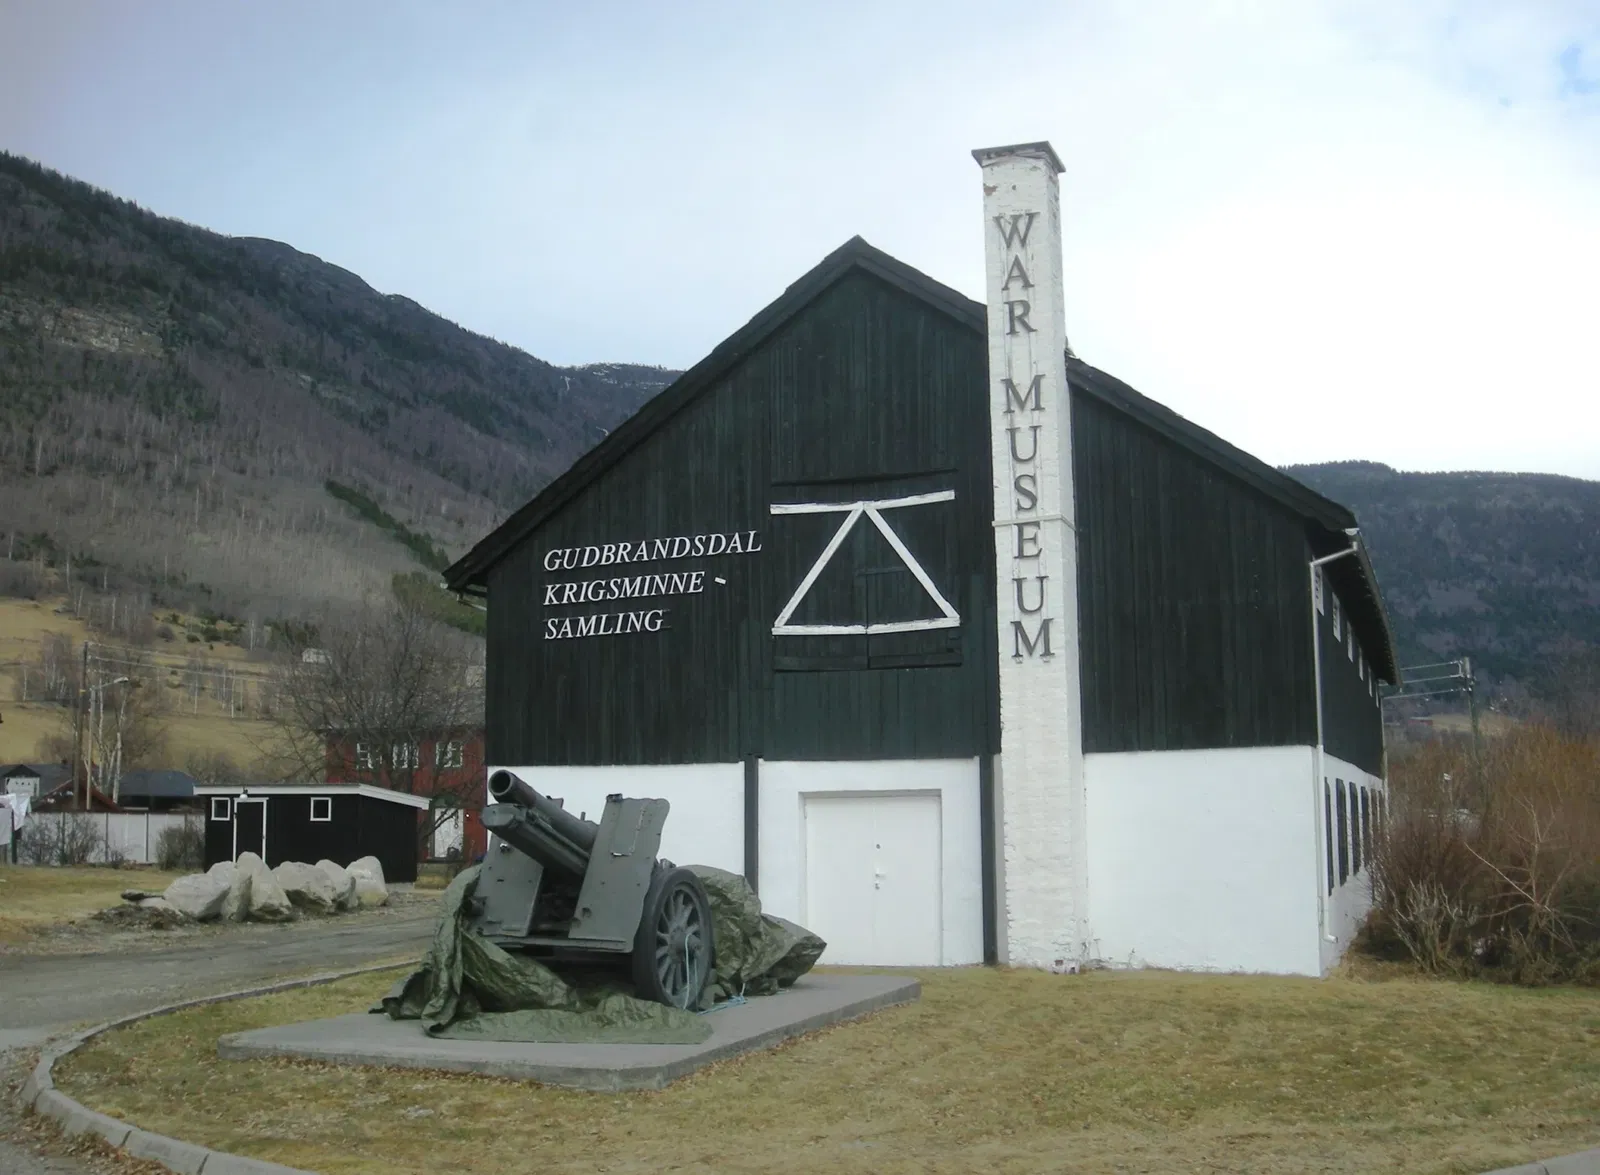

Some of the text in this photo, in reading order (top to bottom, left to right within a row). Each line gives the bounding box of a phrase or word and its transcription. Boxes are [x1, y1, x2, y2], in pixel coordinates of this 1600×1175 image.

[993, 211, 1056, 659] WAR MUSEUM
[543, 530, 763, 572] GUDBRANDSDAL
[544, 608, 664, 640] SAMLING
